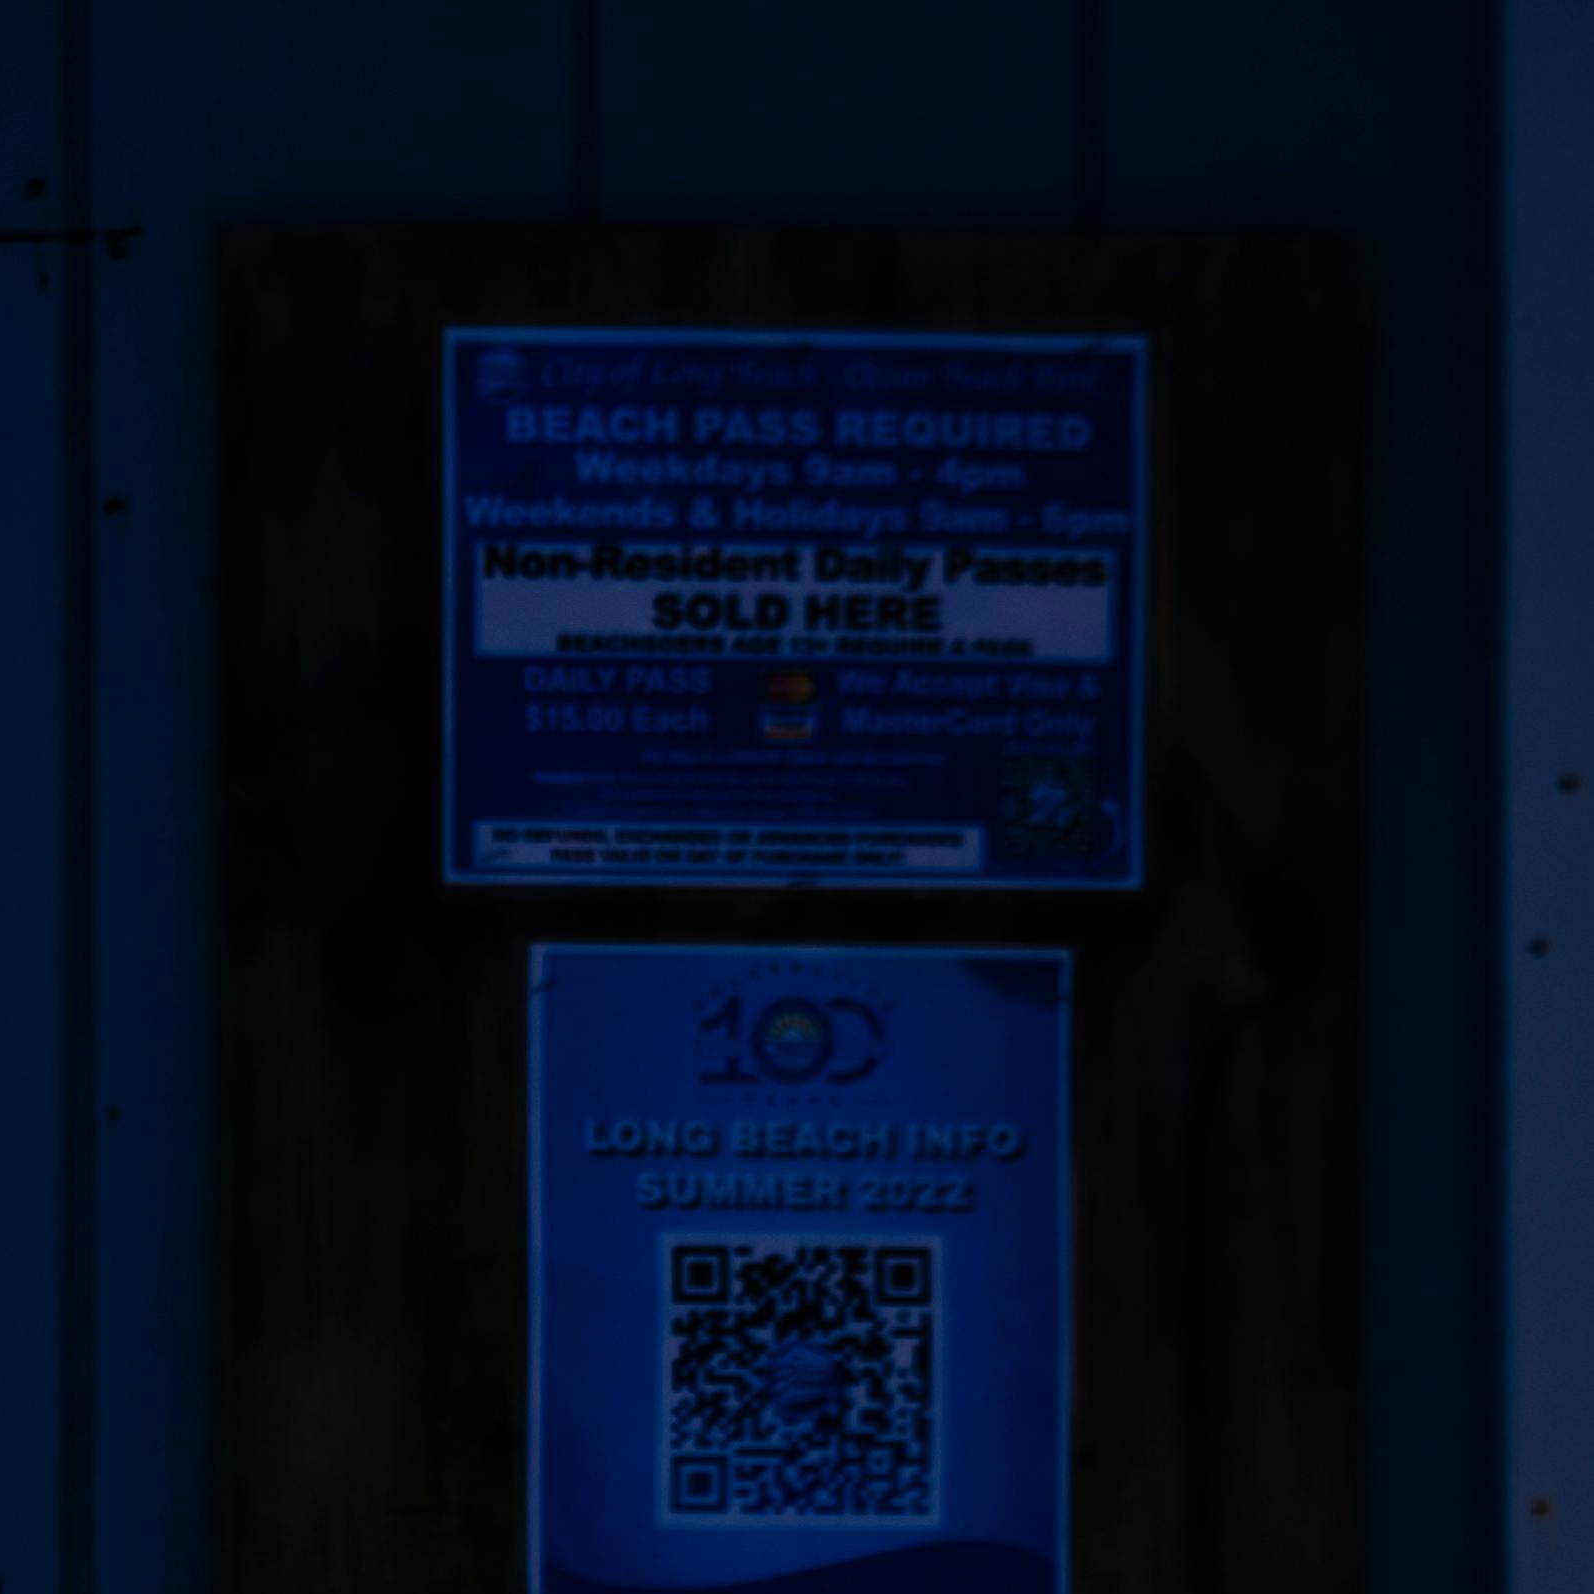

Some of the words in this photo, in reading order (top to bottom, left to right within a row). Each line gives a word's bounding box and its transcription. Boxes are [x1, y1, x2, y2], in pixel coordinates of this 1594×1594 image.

[507, 407, 678, 444] BEACH
[695, 409, 823, 446] PASS
[835, 411, 1092, 451] REQUIRED
[575, 453, 793, 491] Weekdays
[802, 456, 898, 488] 9am
[934, 457, 1028, 494] 4pm
[466, 496, 677, 529] Weekends
[688, 497, 724, 531] &
[733, 497, 909, 537] Holidays
[918, 500, 1010, 533] 9am
[1042, 501, 1135, 540] 6pm
[484, 543, 800, 582] Non-Resident
[814, 545, 932, 592] Daily
[945, 547, 1107, 587] Passes
[651, 594, 791, 631] SOLD
[804, 596, 943, 632] HERE
[522, 665, 617, 695] DAILY
[624, 666, 712, 696] PASS
[893, 670, 998, 702] Accept
[633, 706, 710, 733] Each
[583, 1119, 718, 1160] LONG
[731, 1120, 896, 1160] BEACH
[909, 1122, 1026, 1161] INFO
[635, 1171, 848, 1209] SUMMER
[858, 1173, 975, 1213] 2022
